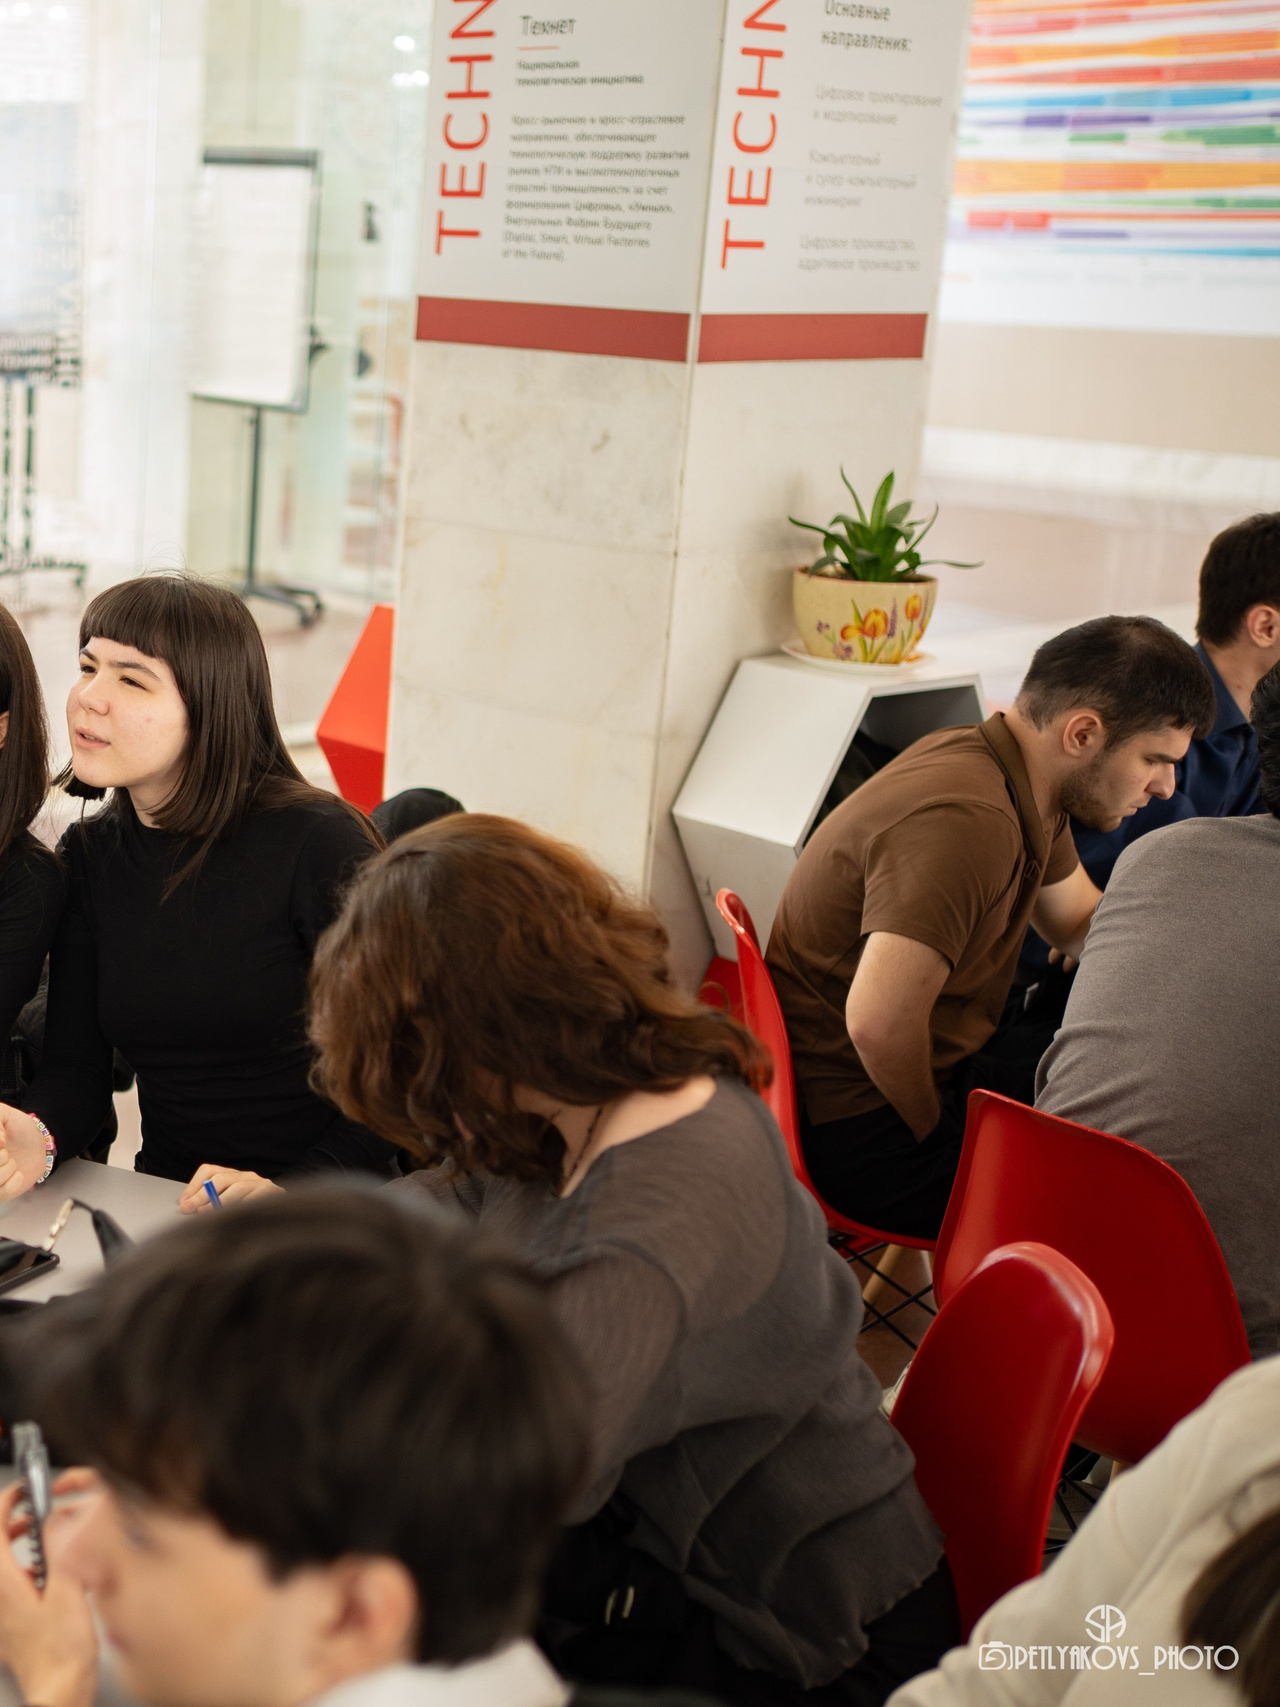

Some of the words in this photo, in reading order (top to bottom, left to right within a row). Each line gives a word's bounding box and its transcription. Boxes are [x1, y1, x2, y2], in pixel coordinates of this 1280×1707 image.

[824, 0, 890, 21] Основные
[520, 15, 576, 36] Технет
[821, 30, 912, 52] направления:
